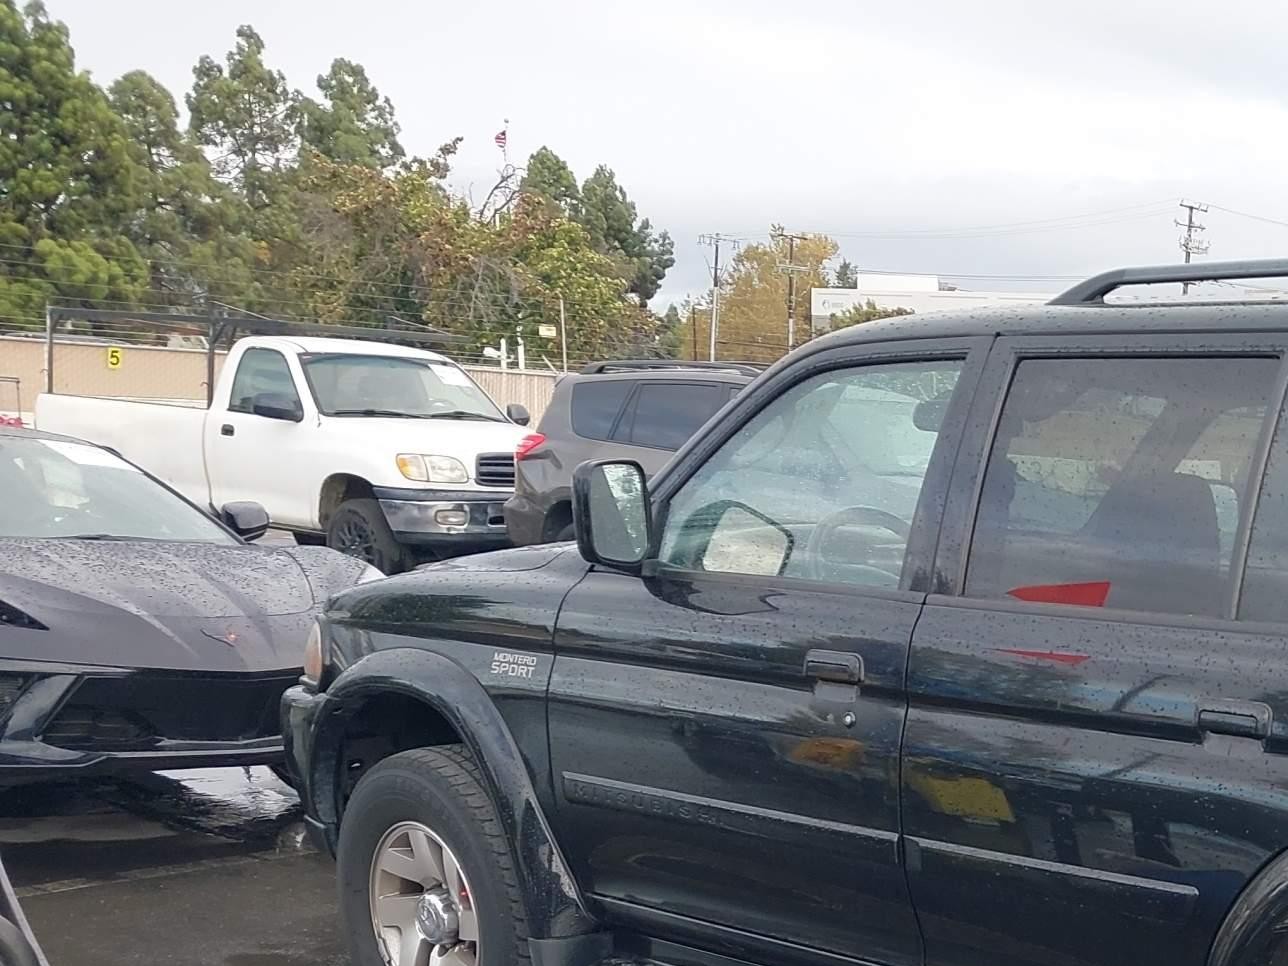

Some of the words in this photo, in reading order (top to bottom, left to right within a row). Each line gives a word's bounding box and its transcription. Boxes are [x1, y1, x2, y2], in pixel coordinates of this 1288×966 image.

[110, 350, 120, 366] 5
[493, 652, 537, 667] MONTERO
[490, 661, 536, 679] SPORT
